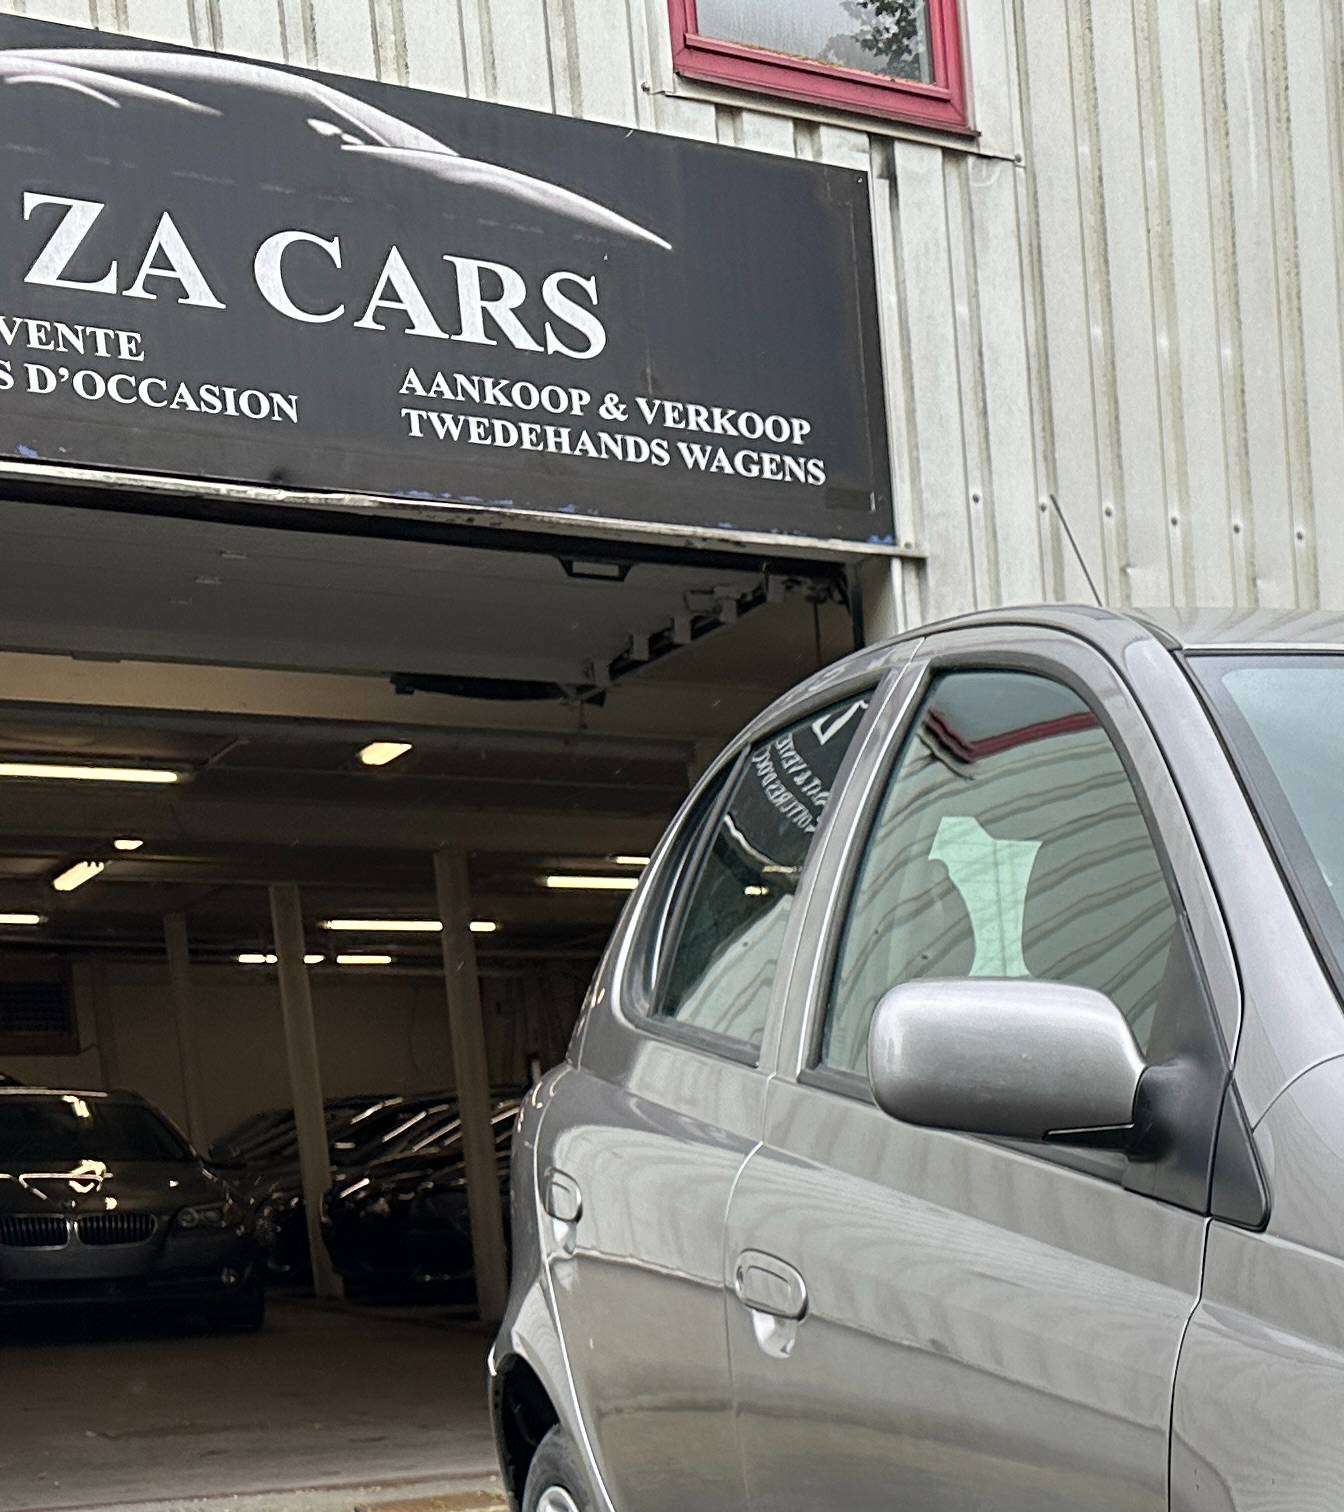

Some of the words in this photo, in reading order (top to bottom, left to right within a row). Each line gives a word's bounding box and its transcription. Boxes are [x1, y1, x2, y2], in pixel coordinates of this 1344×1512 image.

[23, 191, 226, 309] ZA
[254, 229, 606, 360] CARS
[0, 316, 145, 361] VENTE
[24, 362, 299, 424] D'OCCASION
[399, 367, 591, 417] AANKOOP
[598, 392, 629, 422] &
[634, 396, 812, 445] VERKOOP
[401, 408, 671, 467] TWEDEHANDS
[677, 441, 827, 486] WAGENS
